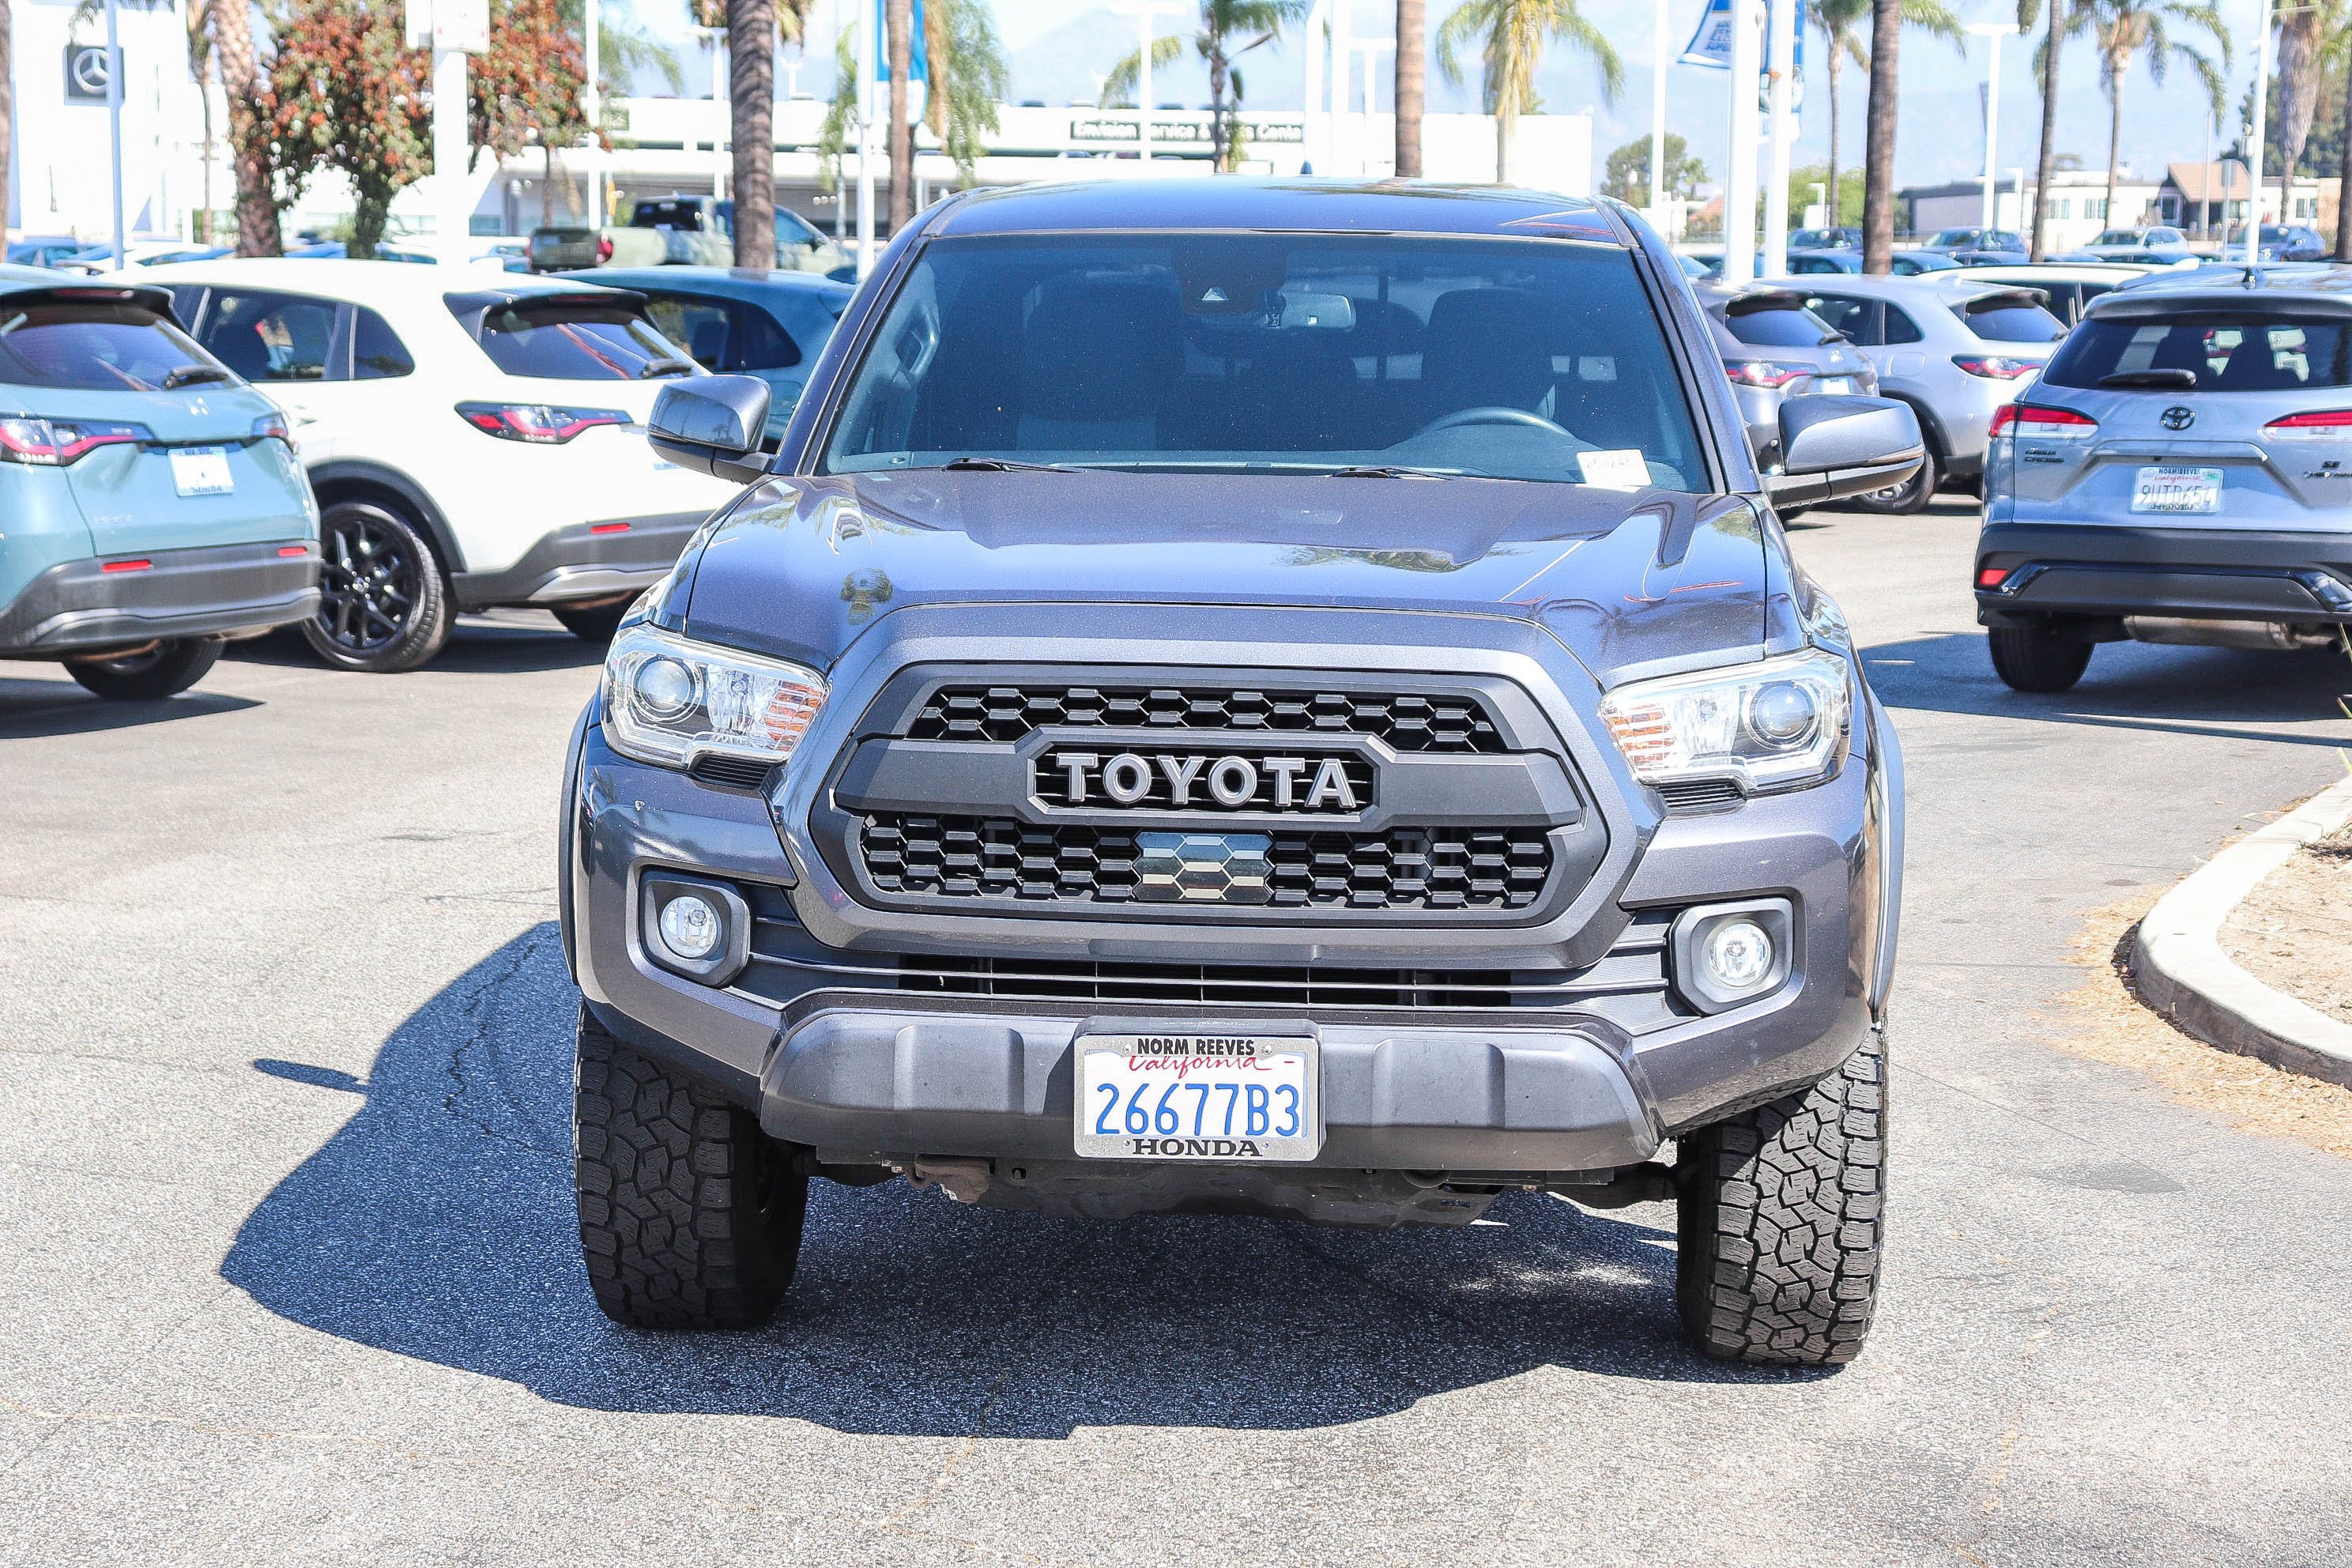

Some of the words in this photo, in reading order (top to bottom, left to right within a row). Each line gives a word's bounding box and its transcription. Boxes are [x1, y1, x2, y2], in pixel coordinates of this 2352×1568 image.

[1151, 122, 1196, 140] ervice
[1257, 122, 1302, 141] Cente
[1056, 752, 1357, 808] TOYOTA
[1137, 1038, 1189, 1055] NORM
[1196, 1038, 1255, 1056] REEVES
[1129, 1056, 1272, 1079] California
[1096, 1083, 1299, 1136] 26677B3
[1132, 1138, 1263, 1157] HONDA
